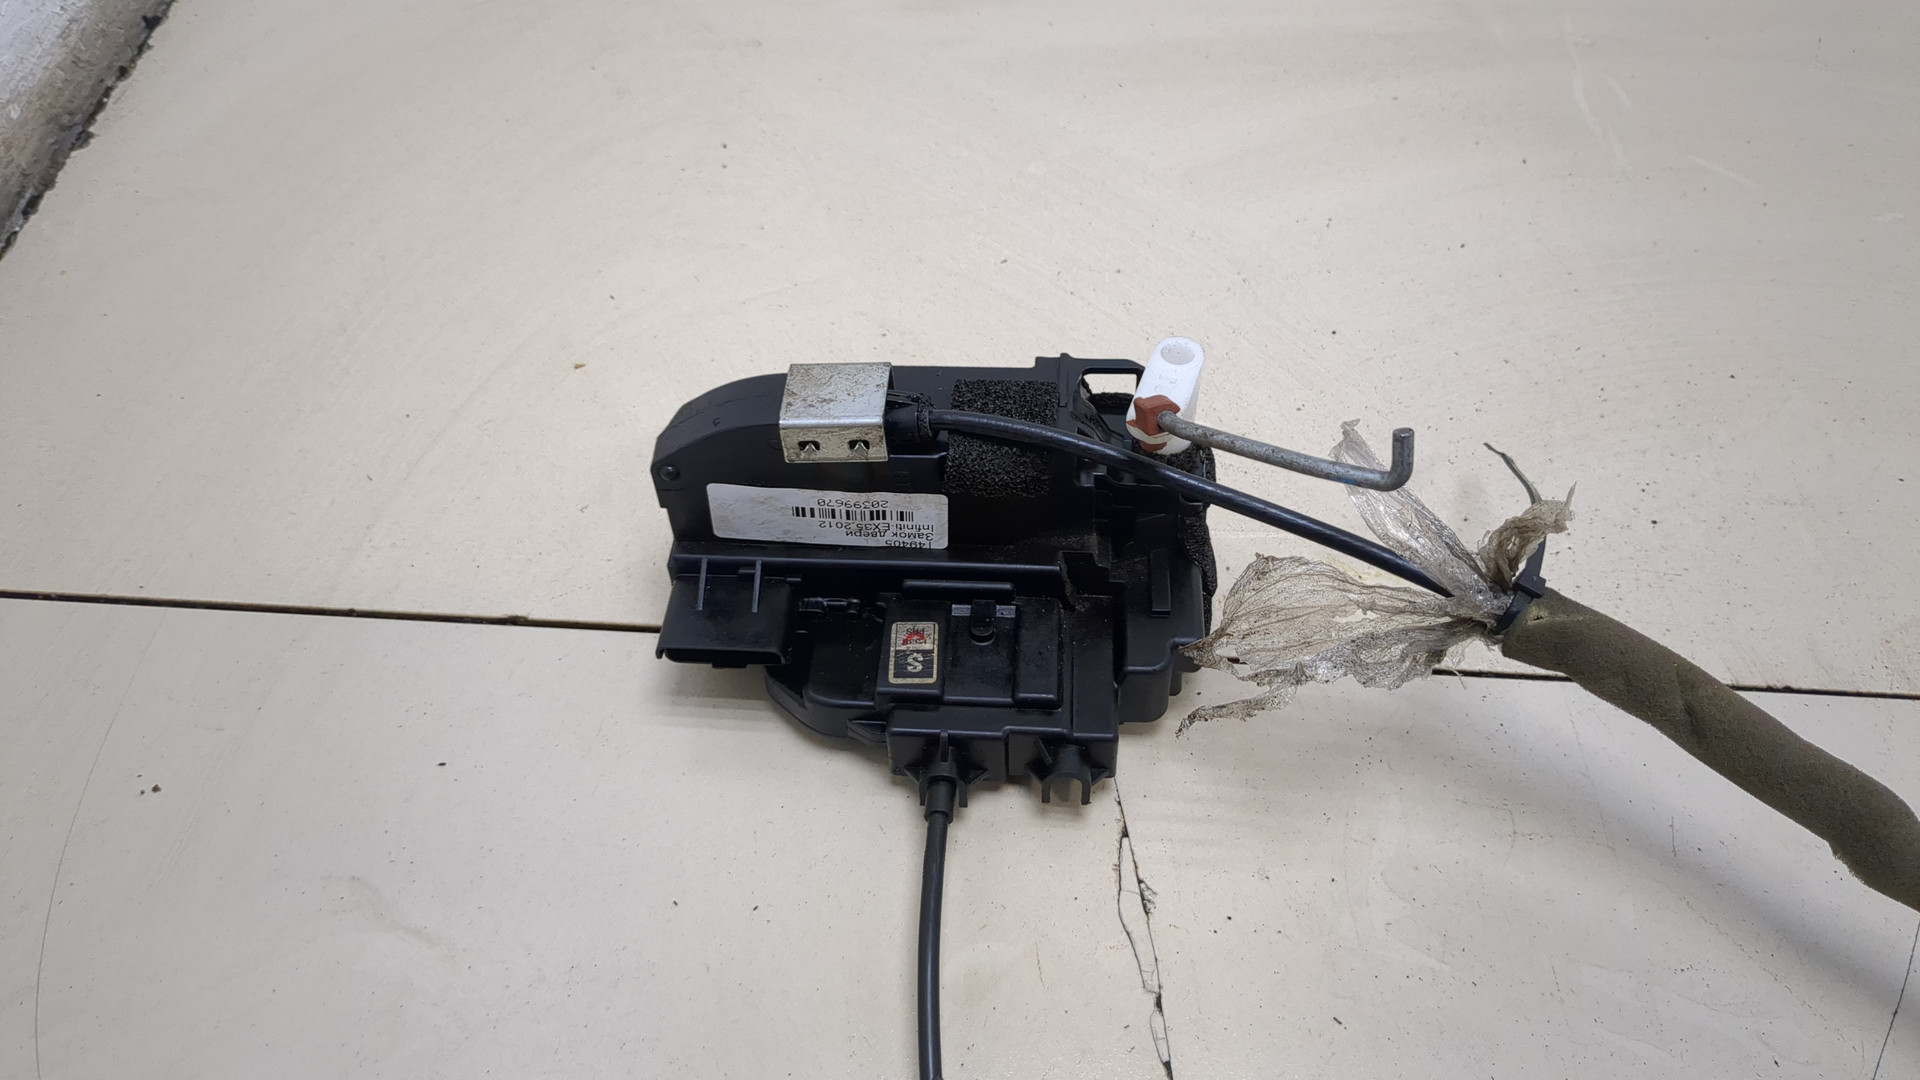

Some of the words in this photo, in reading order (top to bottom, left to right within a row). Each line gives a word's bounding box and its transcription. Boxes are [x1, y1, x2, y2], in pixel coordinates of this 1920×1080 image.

[817, 499, 889, 509] 20399670
[846, 529, 887, 538] двери
[891, 531, 934, 541] Замок
